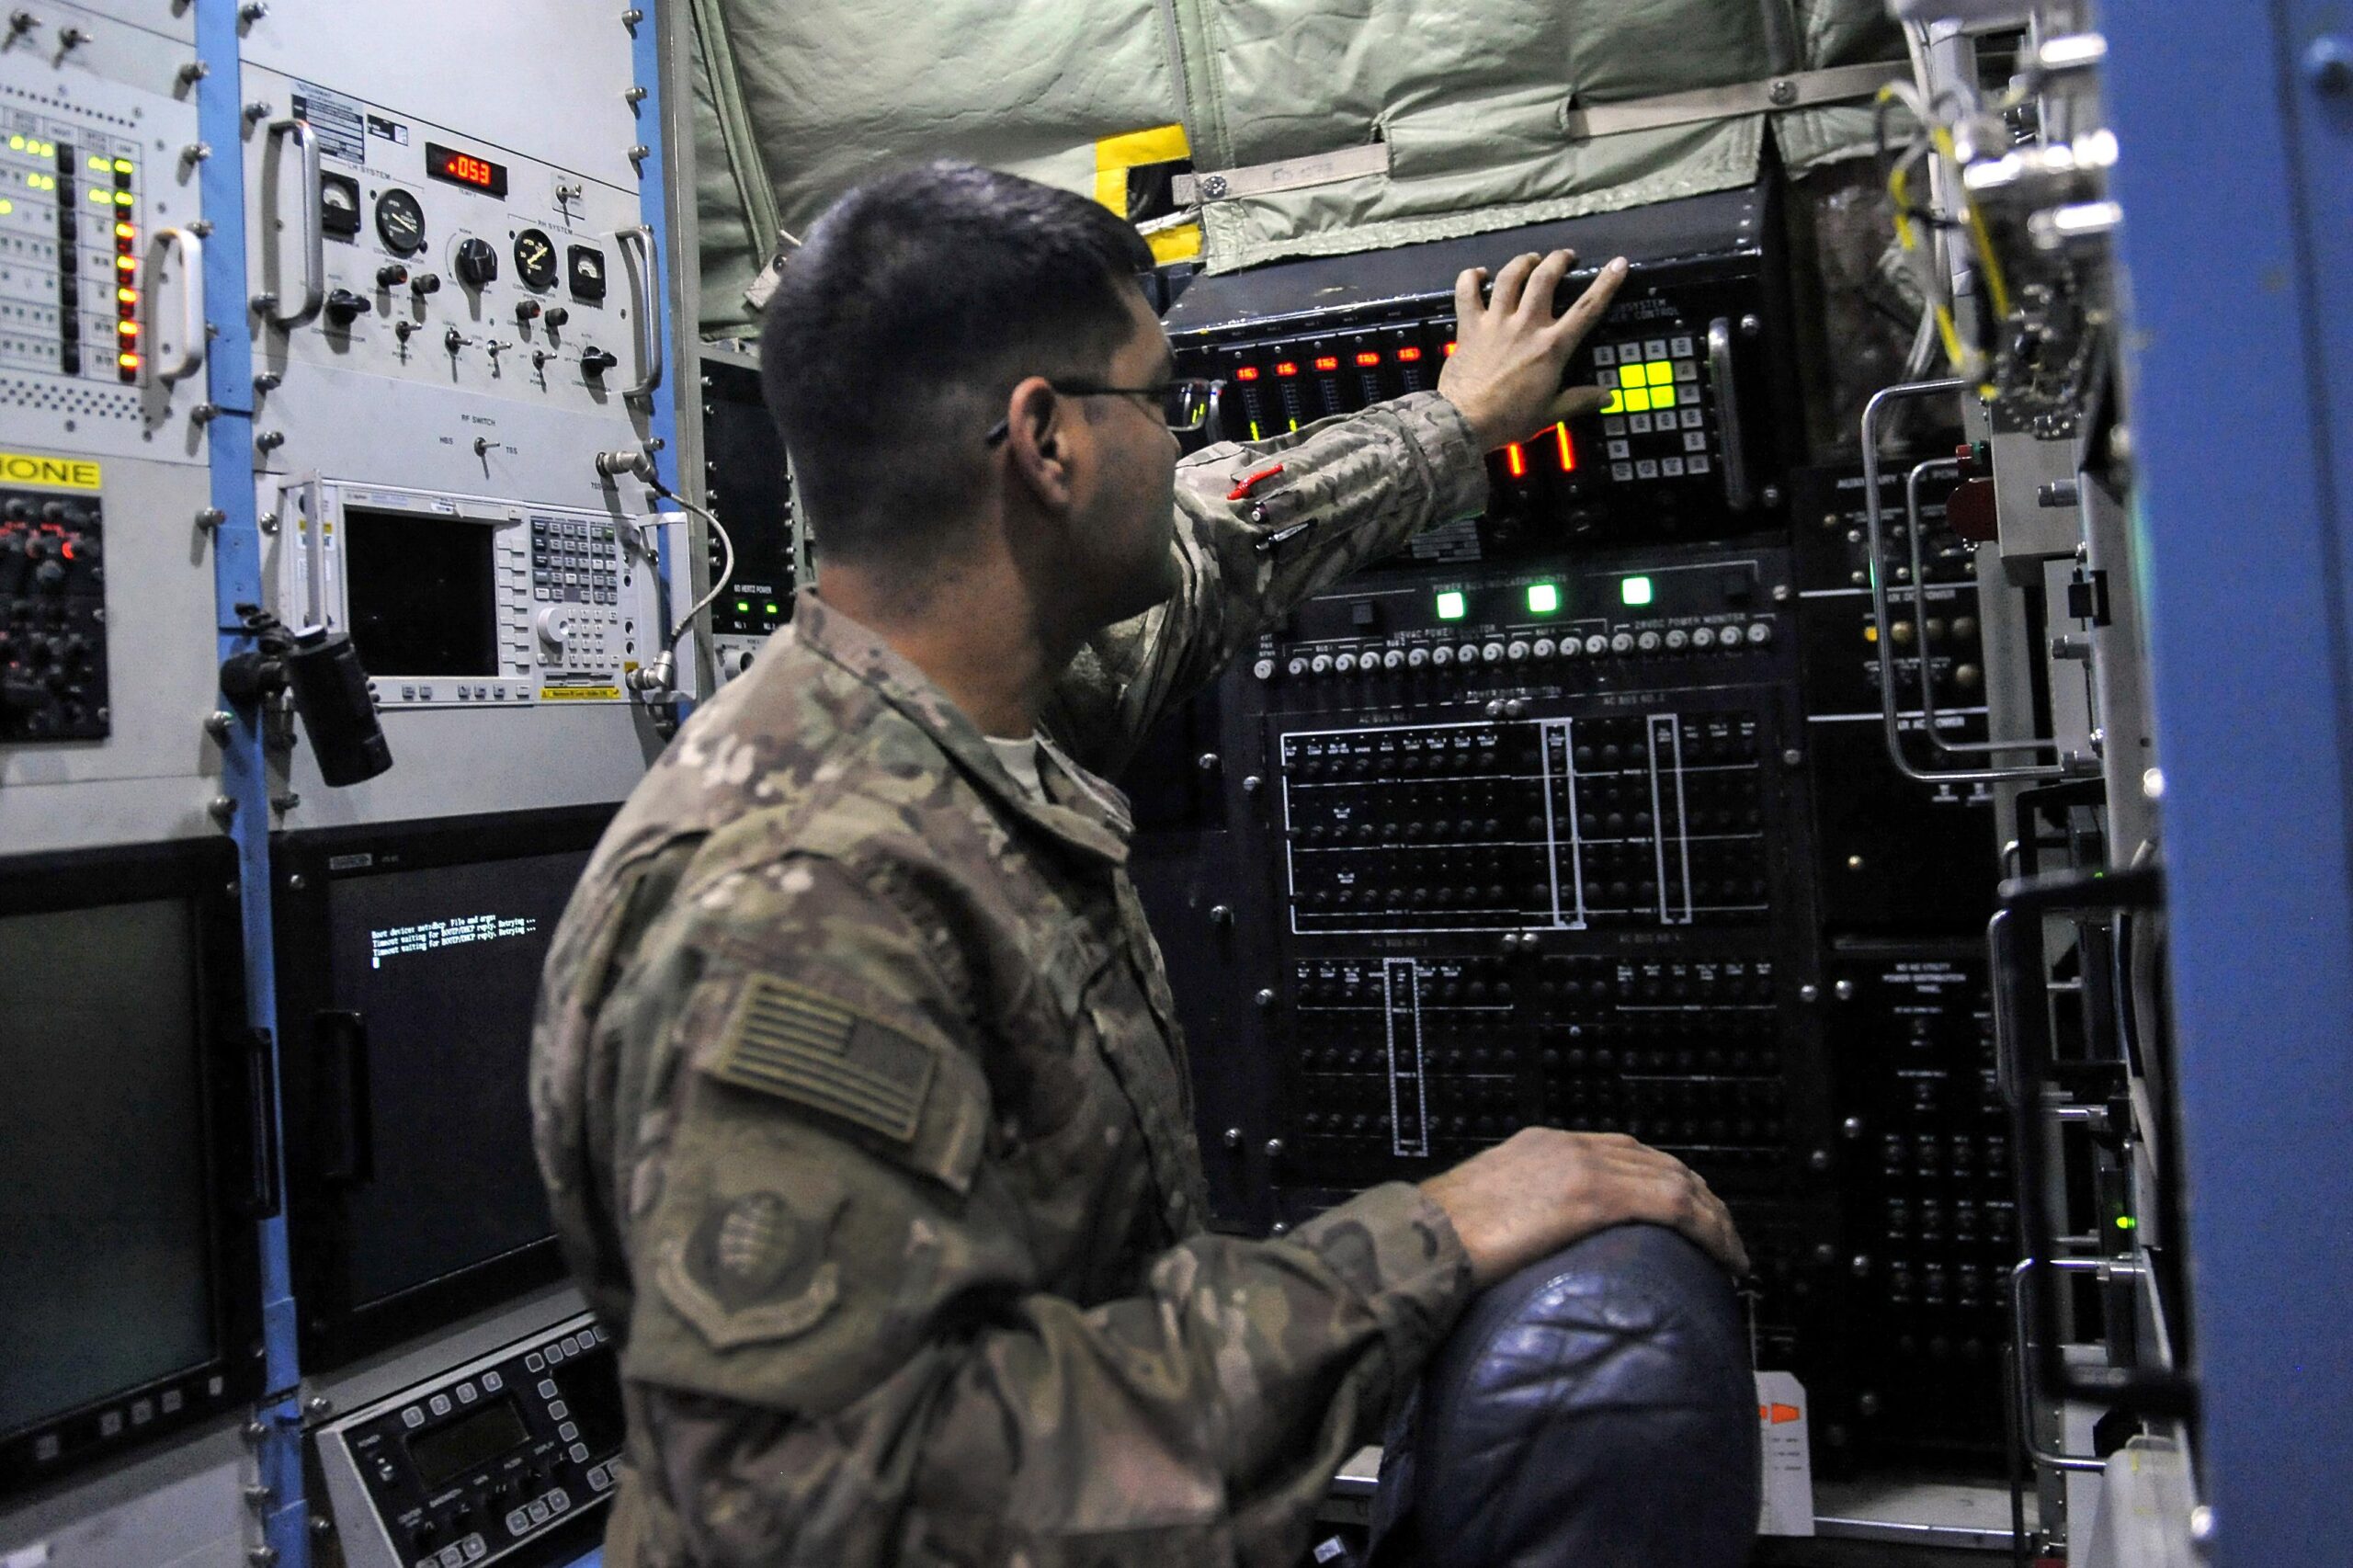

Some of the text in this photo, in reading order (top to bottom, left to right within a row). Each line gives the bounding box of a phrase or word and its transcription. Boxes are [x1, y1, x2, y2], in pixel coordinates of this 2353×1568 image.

[360, 166, 391, 180] SYSTEM
[548, 223, 574, 235] SYSTEM
[472, 416, 496, 426] SWITCH
[506, 447, 518, 455] TSS
[756, 585, 772, 594] POWER
[371, 930, 388, 939] Boot
[450, 917, 466, 927] File
[467, 915, 478, 925] and
[372, 937, 399, 949] Timeout
[401, 934, 426, 944] waiting
[428, 931, 439, 939] for
[498, 918, 525, 928] Retrying
[372, 947, 400, 957] Timeout
[401, 942, 427, 952] waiting
[428, 939, 440, 948] for
[498, 926, 526, 937] Retrying
